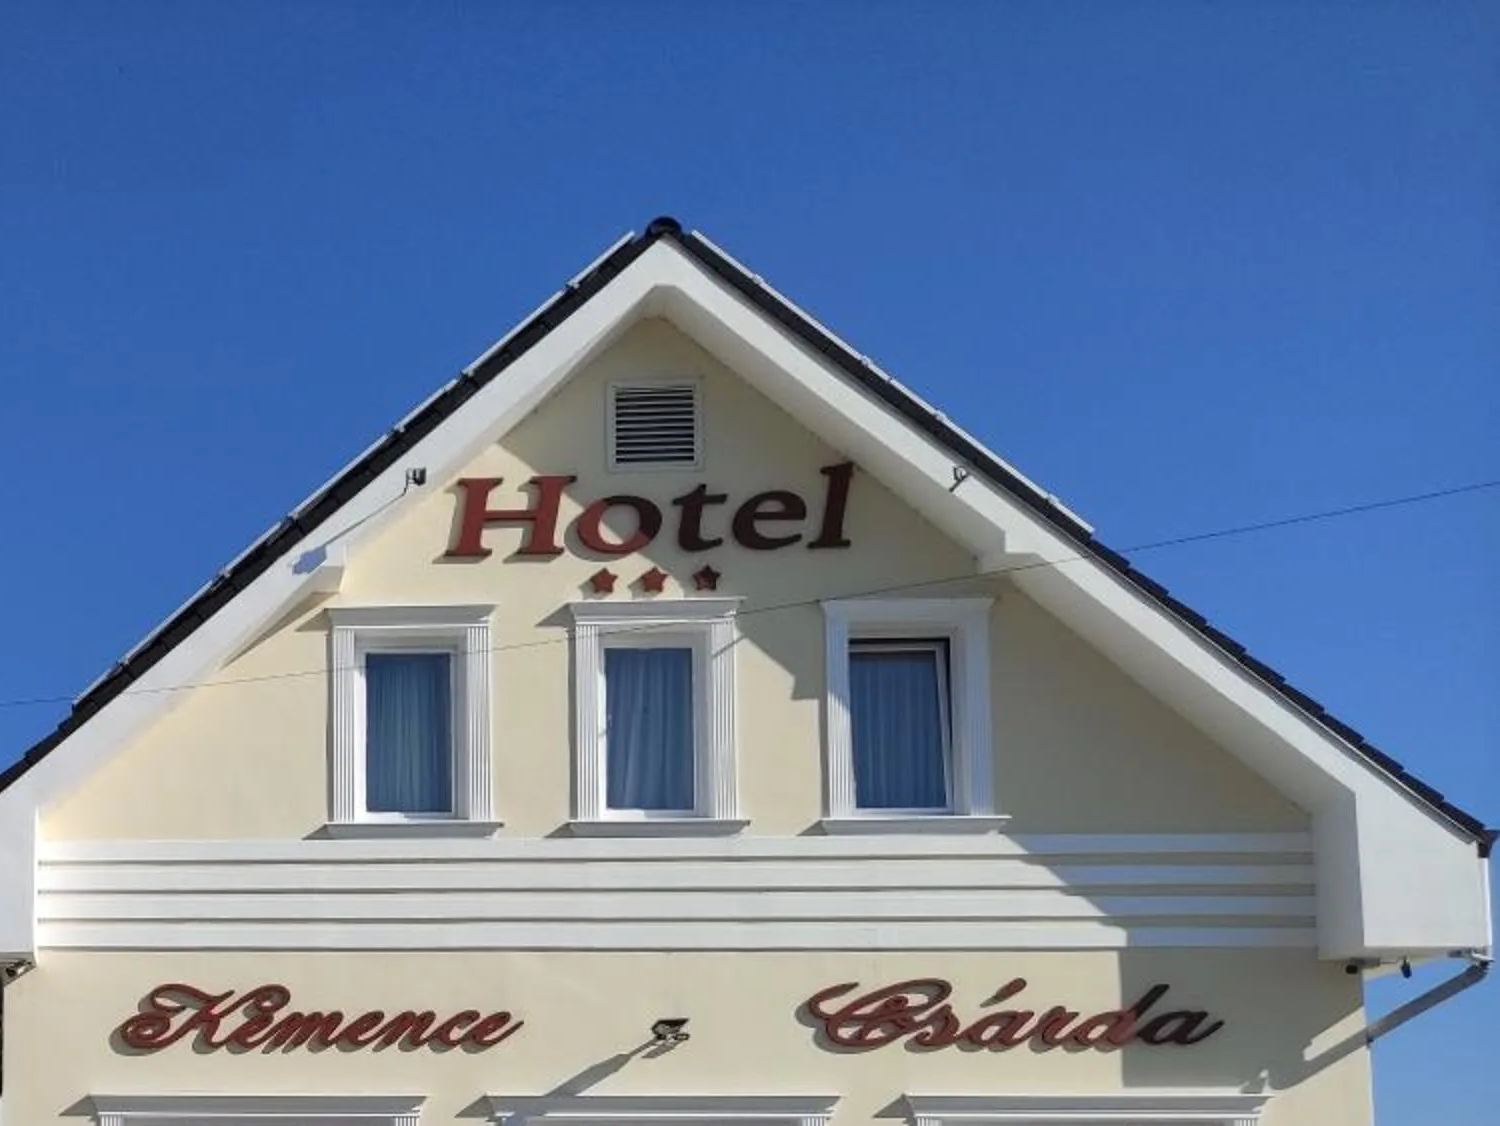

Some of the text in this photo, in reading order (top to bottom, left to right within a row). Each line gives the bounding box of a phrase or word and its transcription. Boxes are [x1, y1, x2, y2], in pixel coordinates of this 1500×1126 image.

[442, 461, 859, 558] Hotel
[119, 977, 1225, 1050] Kemence Csárda
